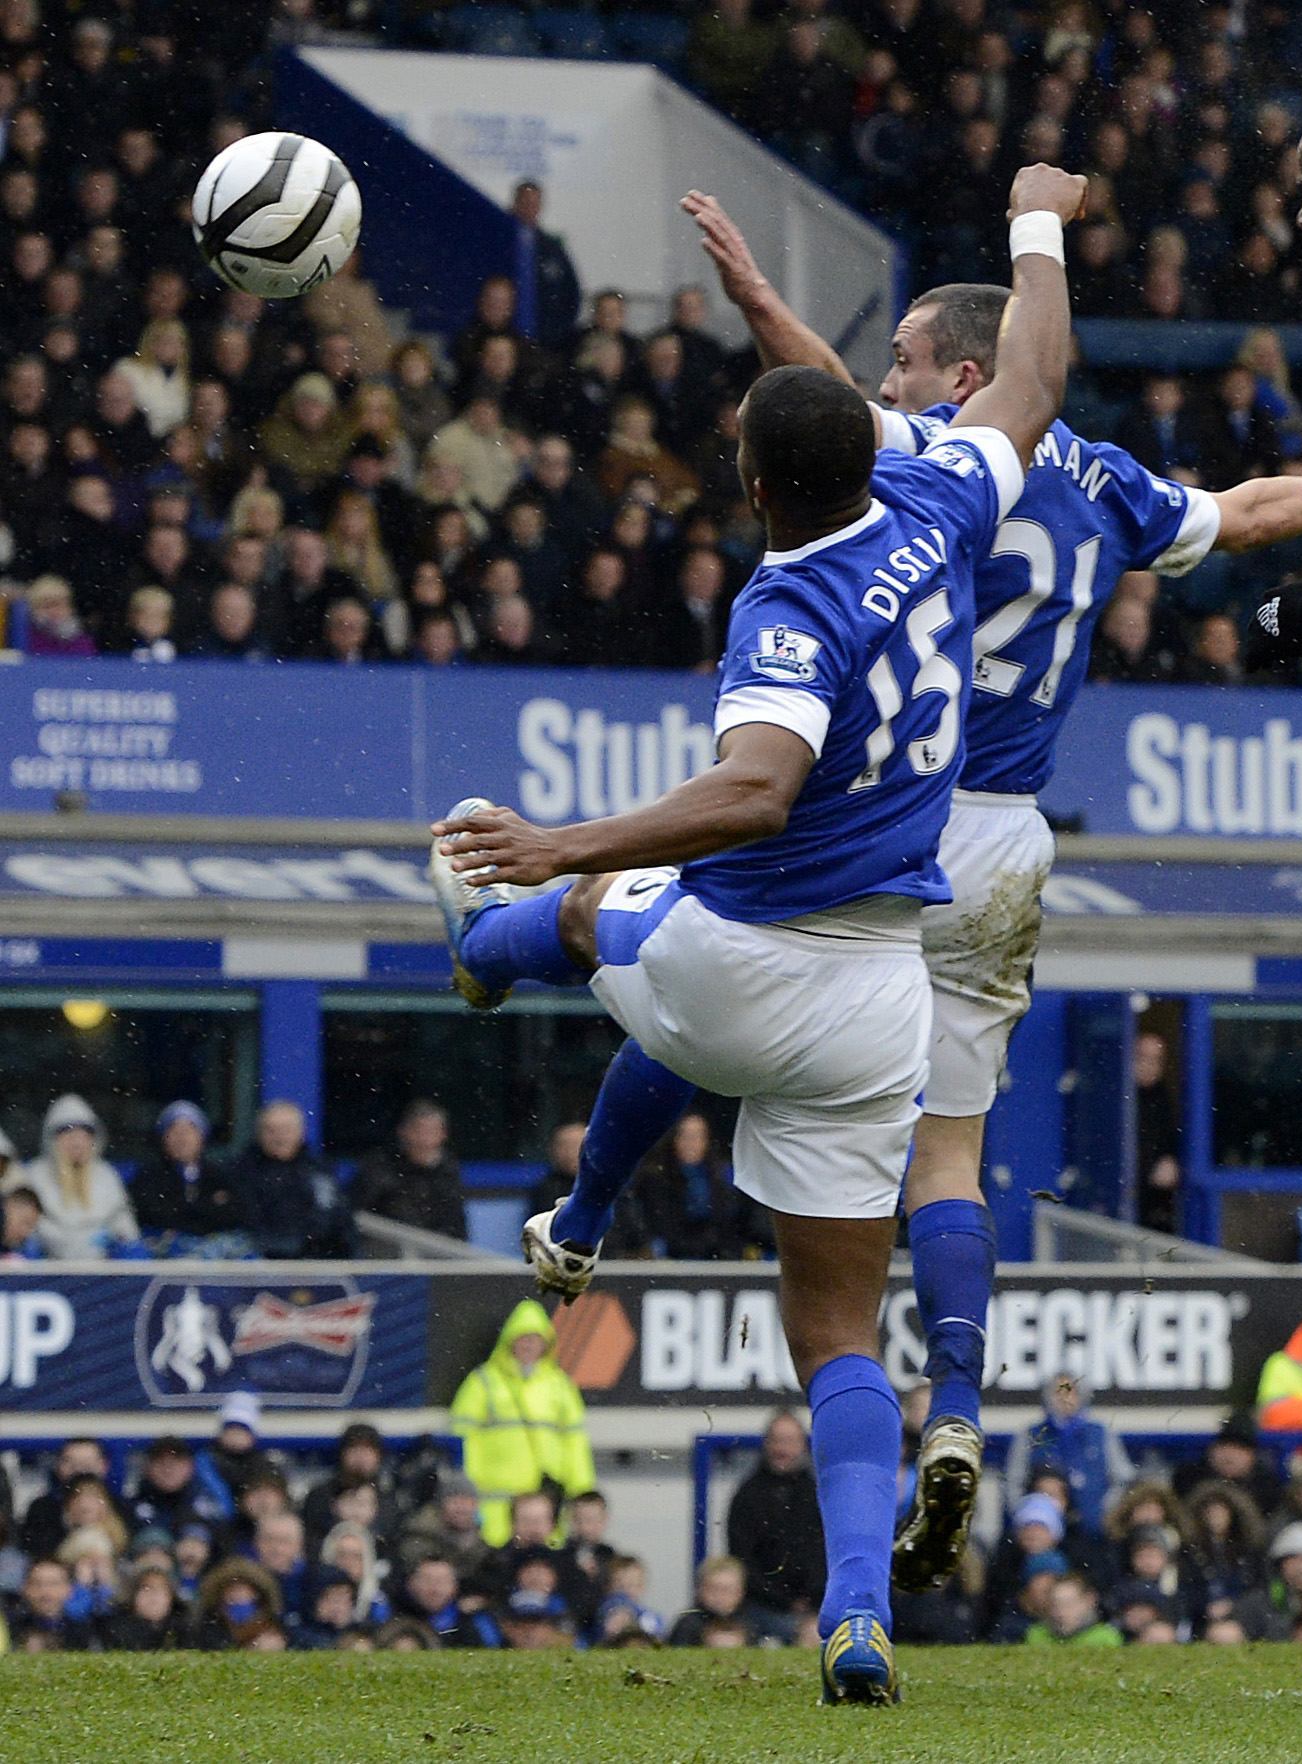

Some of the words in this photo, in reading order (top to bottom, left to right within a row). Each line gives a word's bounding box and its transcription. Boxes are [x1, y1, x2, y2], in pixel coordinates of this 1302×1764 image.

[972, 518, 1102, 709] 21
[33, 688, 178, 723] SUPERIOR
[847, 587, 963, 793] 15
[38, 724, 173, 757] QUALITY
[11, 756, 84, 790] SOFT
[90, 759, 203, 793] DRINKS
